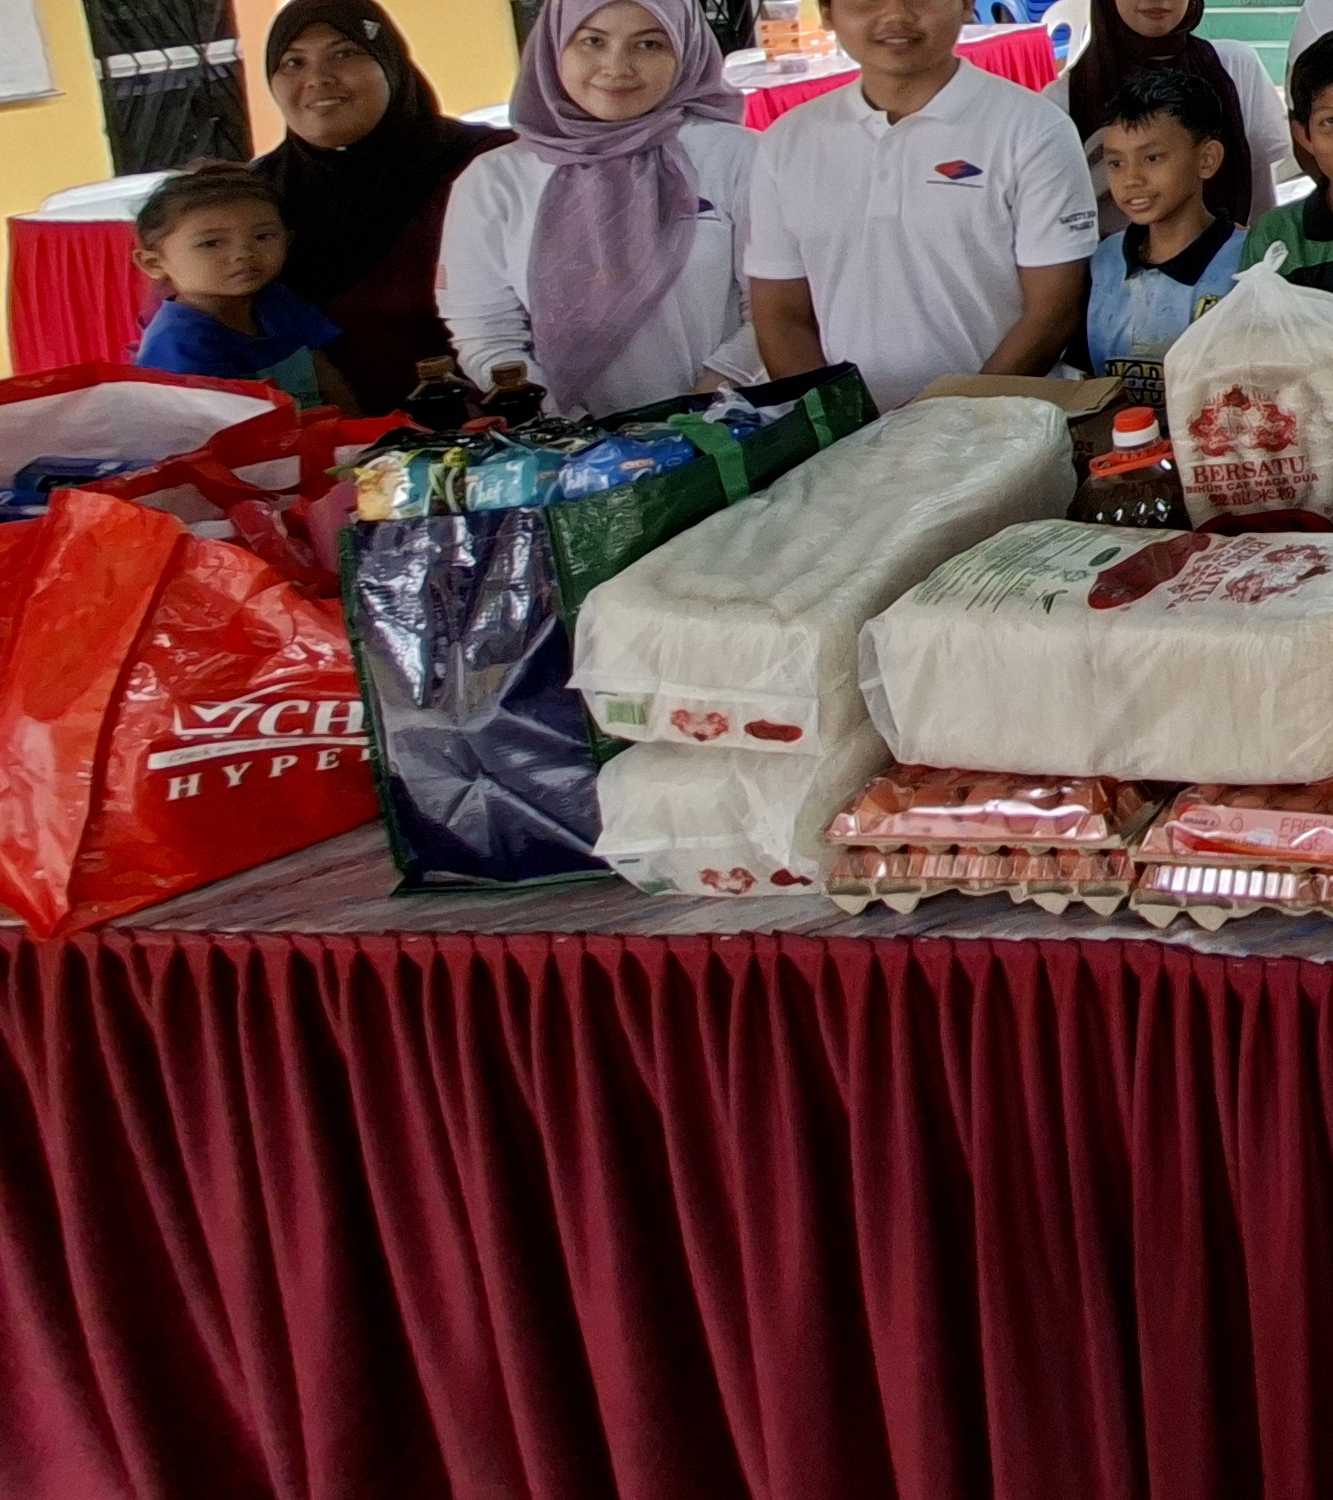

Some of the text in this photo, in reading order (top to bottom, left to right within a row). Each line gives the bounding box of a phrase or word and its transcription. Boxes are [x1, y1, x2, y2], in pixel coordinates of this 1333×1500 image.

[1192, 456, 1305, 484] BERSATU
[1226, 482, 1251, 491] CAP
[1255, 477, 1290, 488] NAGA
[1293, 473, 1319, 483] DUA
